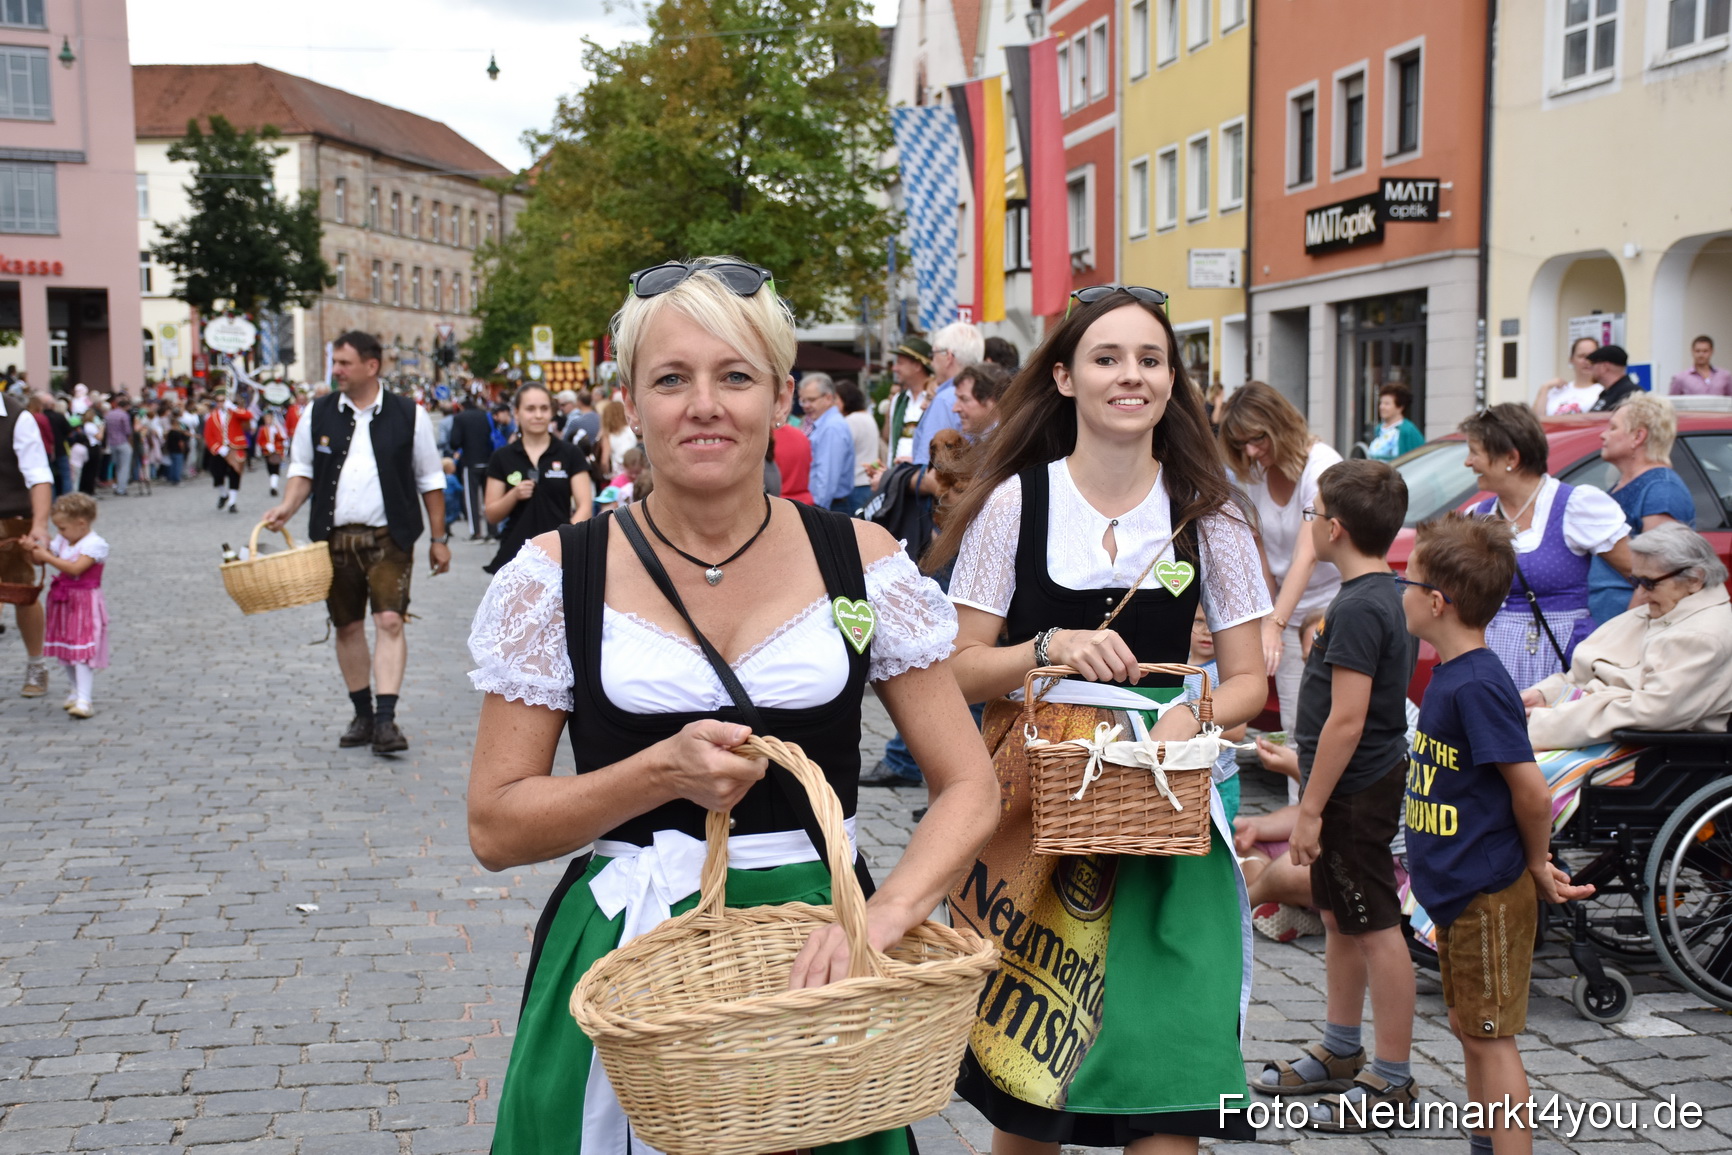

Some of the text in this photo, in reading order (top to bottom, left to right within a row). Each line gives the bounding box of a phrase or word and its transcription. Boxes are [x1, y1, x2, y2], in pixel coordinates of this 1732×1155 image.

[1384, 181, 1437, 202] MATT
[1389, 203, 1428, 219] optik
[1429, 737, 1460, 771] THE
